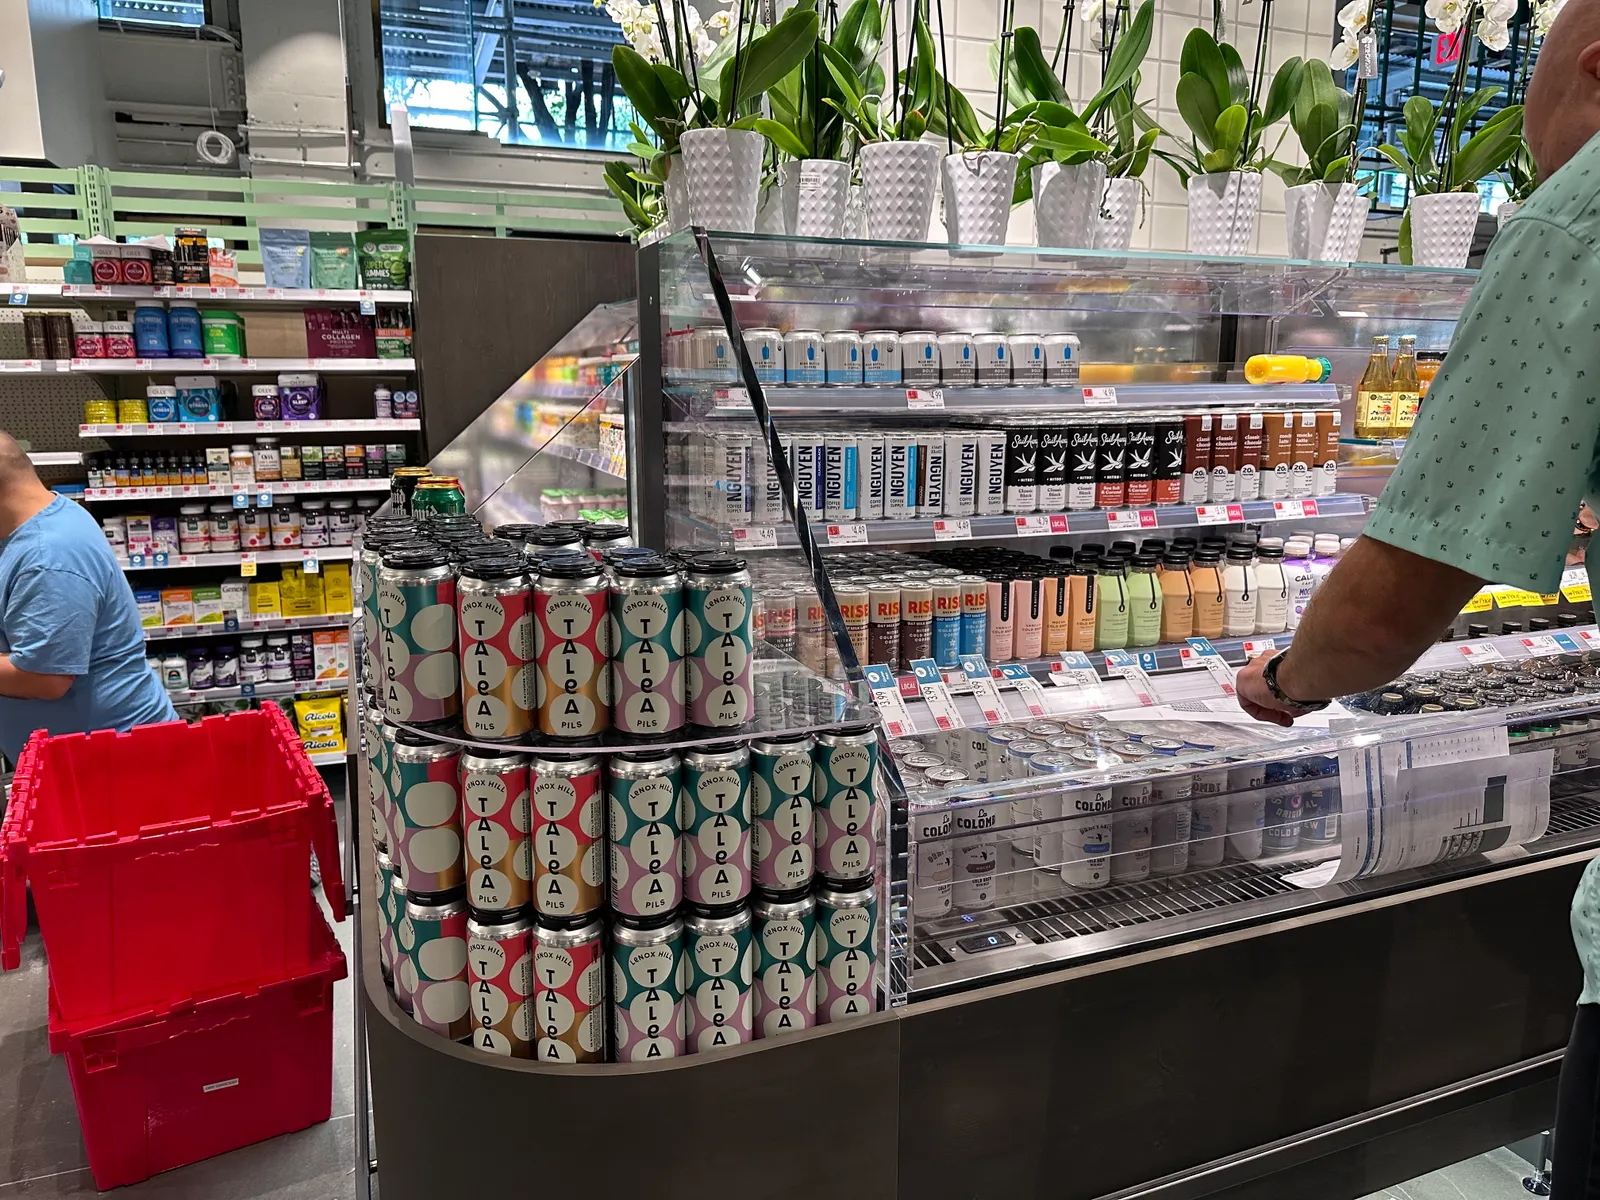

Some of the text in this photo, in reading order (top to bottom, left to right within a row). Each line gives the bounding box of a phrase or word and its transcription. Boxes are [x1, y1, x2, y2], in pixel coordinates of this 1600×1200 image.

[364, 261, 382, 269] SUPER
[726, 446, 742, 501] NGUYEN
[798, 446, 812, 499] NGUYEN
[827, 446, 841, 499] NGUYEN
[870, 446, 882, 497] NGUYEN
[891, 446, 905, 496] NGUYEN
[960, 444, 974, 495] NGUYEN
[989, 444, 1003, 494] NGUYEN
[929, 456, 941, 507] NGUYEN
[1052, 520, 1065, 528] LOCAL
[733, 596, 746, 608] HILL
[965, 594, 986, 606] RIS
[485, 603, 503, 616] HILL
[575, 601, 593, 615] HILL
[651, 601, 667, 614] HILL
[840, 604, 868, 618] RISE
[878, 602, 900, 615] RIS
[304, 712, 336, 721] Ricola
[719, 711, 738, 720] PILS
[476, 722, 495, 730] PILS
[561, 721, 582, 729] PILS
[637, 719, 657, 727] PILS
[303, 740, 337, 749] Ricola
[858, 752, 870, 762] HILL
[726, 776, 740, 787] HILL
[488, 781, 506, 793] HILL
[558, 785, 575, 797] HILL
[659, 784, 673, 794] HILL
[978, 809, 987, 817] La
[957, 816, 995, 829] COLOMB
[842, 860, 860, 868] PILS
[787, 869, 804, 878] PILS
[479, 894, 498, 903] PILS
[712, 890, 731, 898] PILS
[546, 900, 565, 908] PILS
[645, 899, 665, 908] PILS
[857, 914, 869, 923] HILL
[790, 926, 804, 936] HILL
[723, 941, 738, 951] HILL
[488, 946, 504, 958] HILL
[658, 951, 673, 960] HILL
[556, 955, 572, 967] HILL
